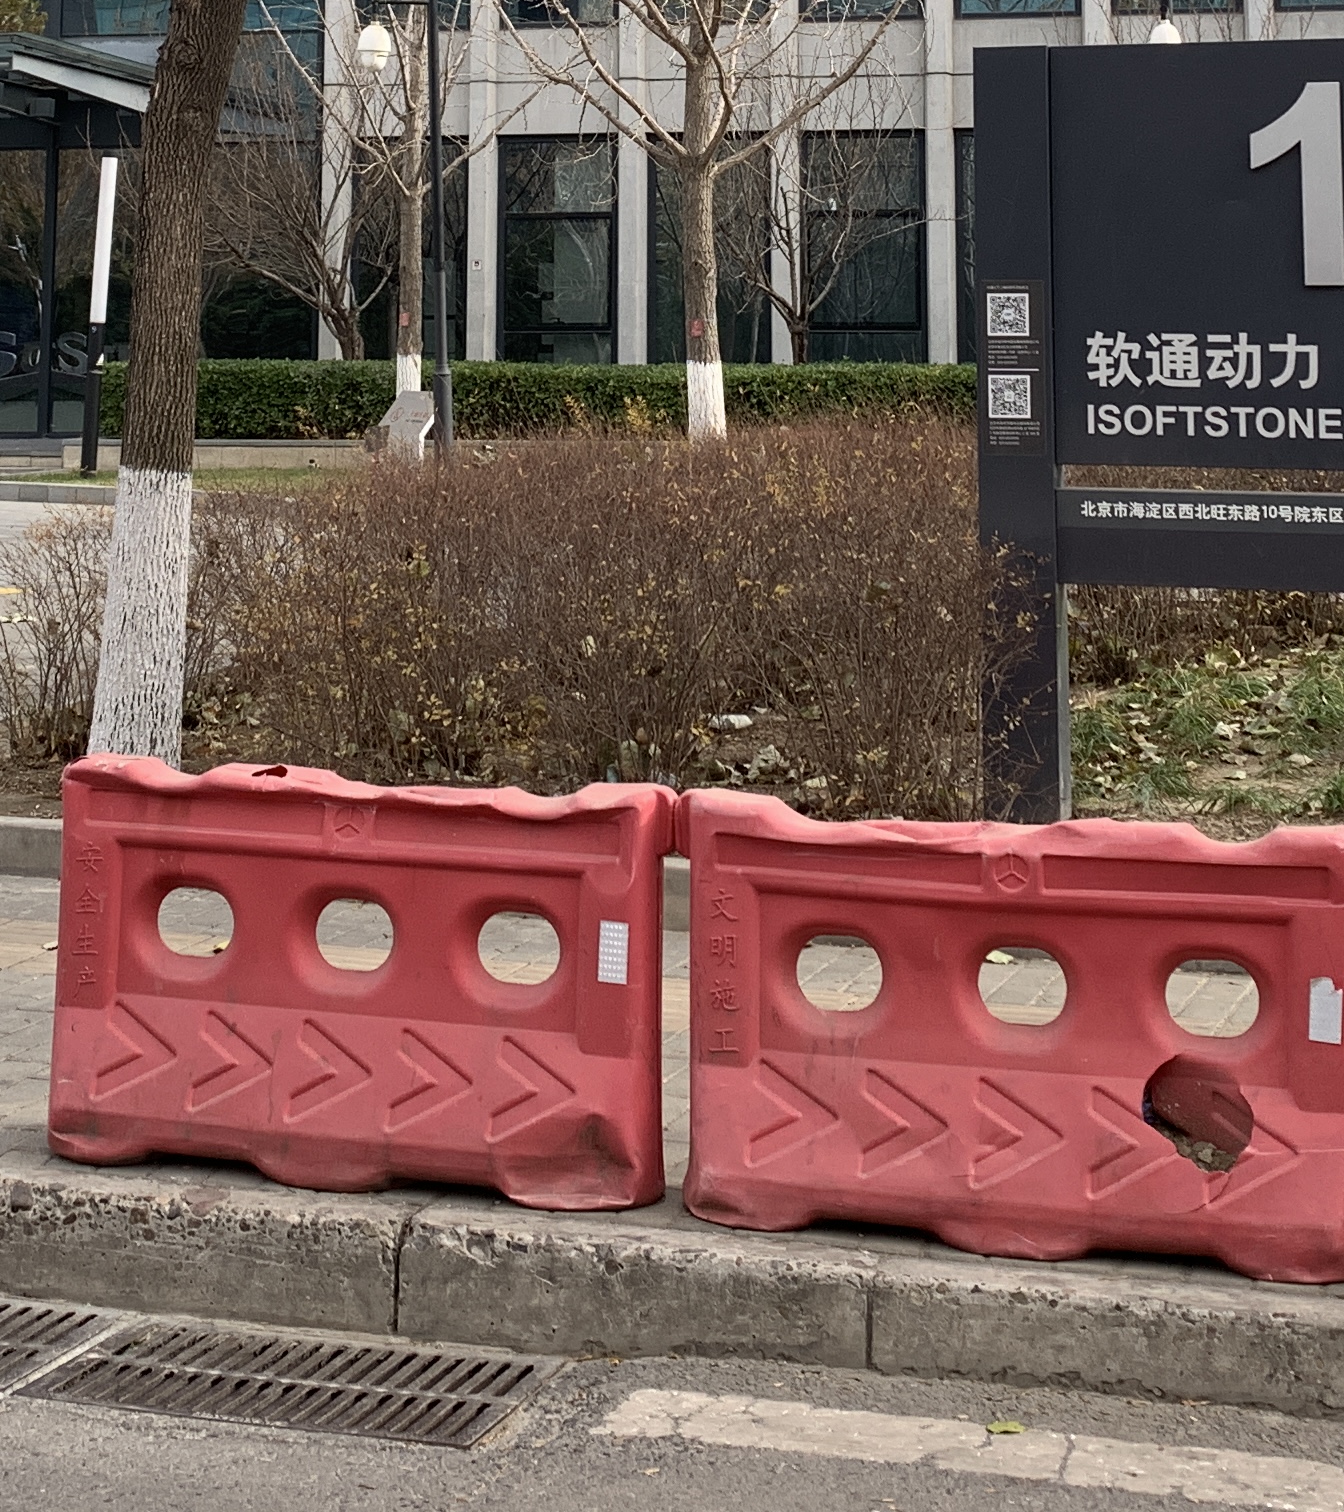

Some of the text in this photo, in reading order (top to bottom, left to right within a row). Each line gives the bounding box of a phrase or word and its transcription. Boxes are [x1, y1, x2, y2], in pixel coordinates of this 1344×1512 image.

[1086, 331, 1320, 390] 软通动力
[1087, 403, 1344, 441] ISOFTSTONE
[71, 840, 105, 999] 安全生产
[708, 888, 740, 1052] 文明施工
